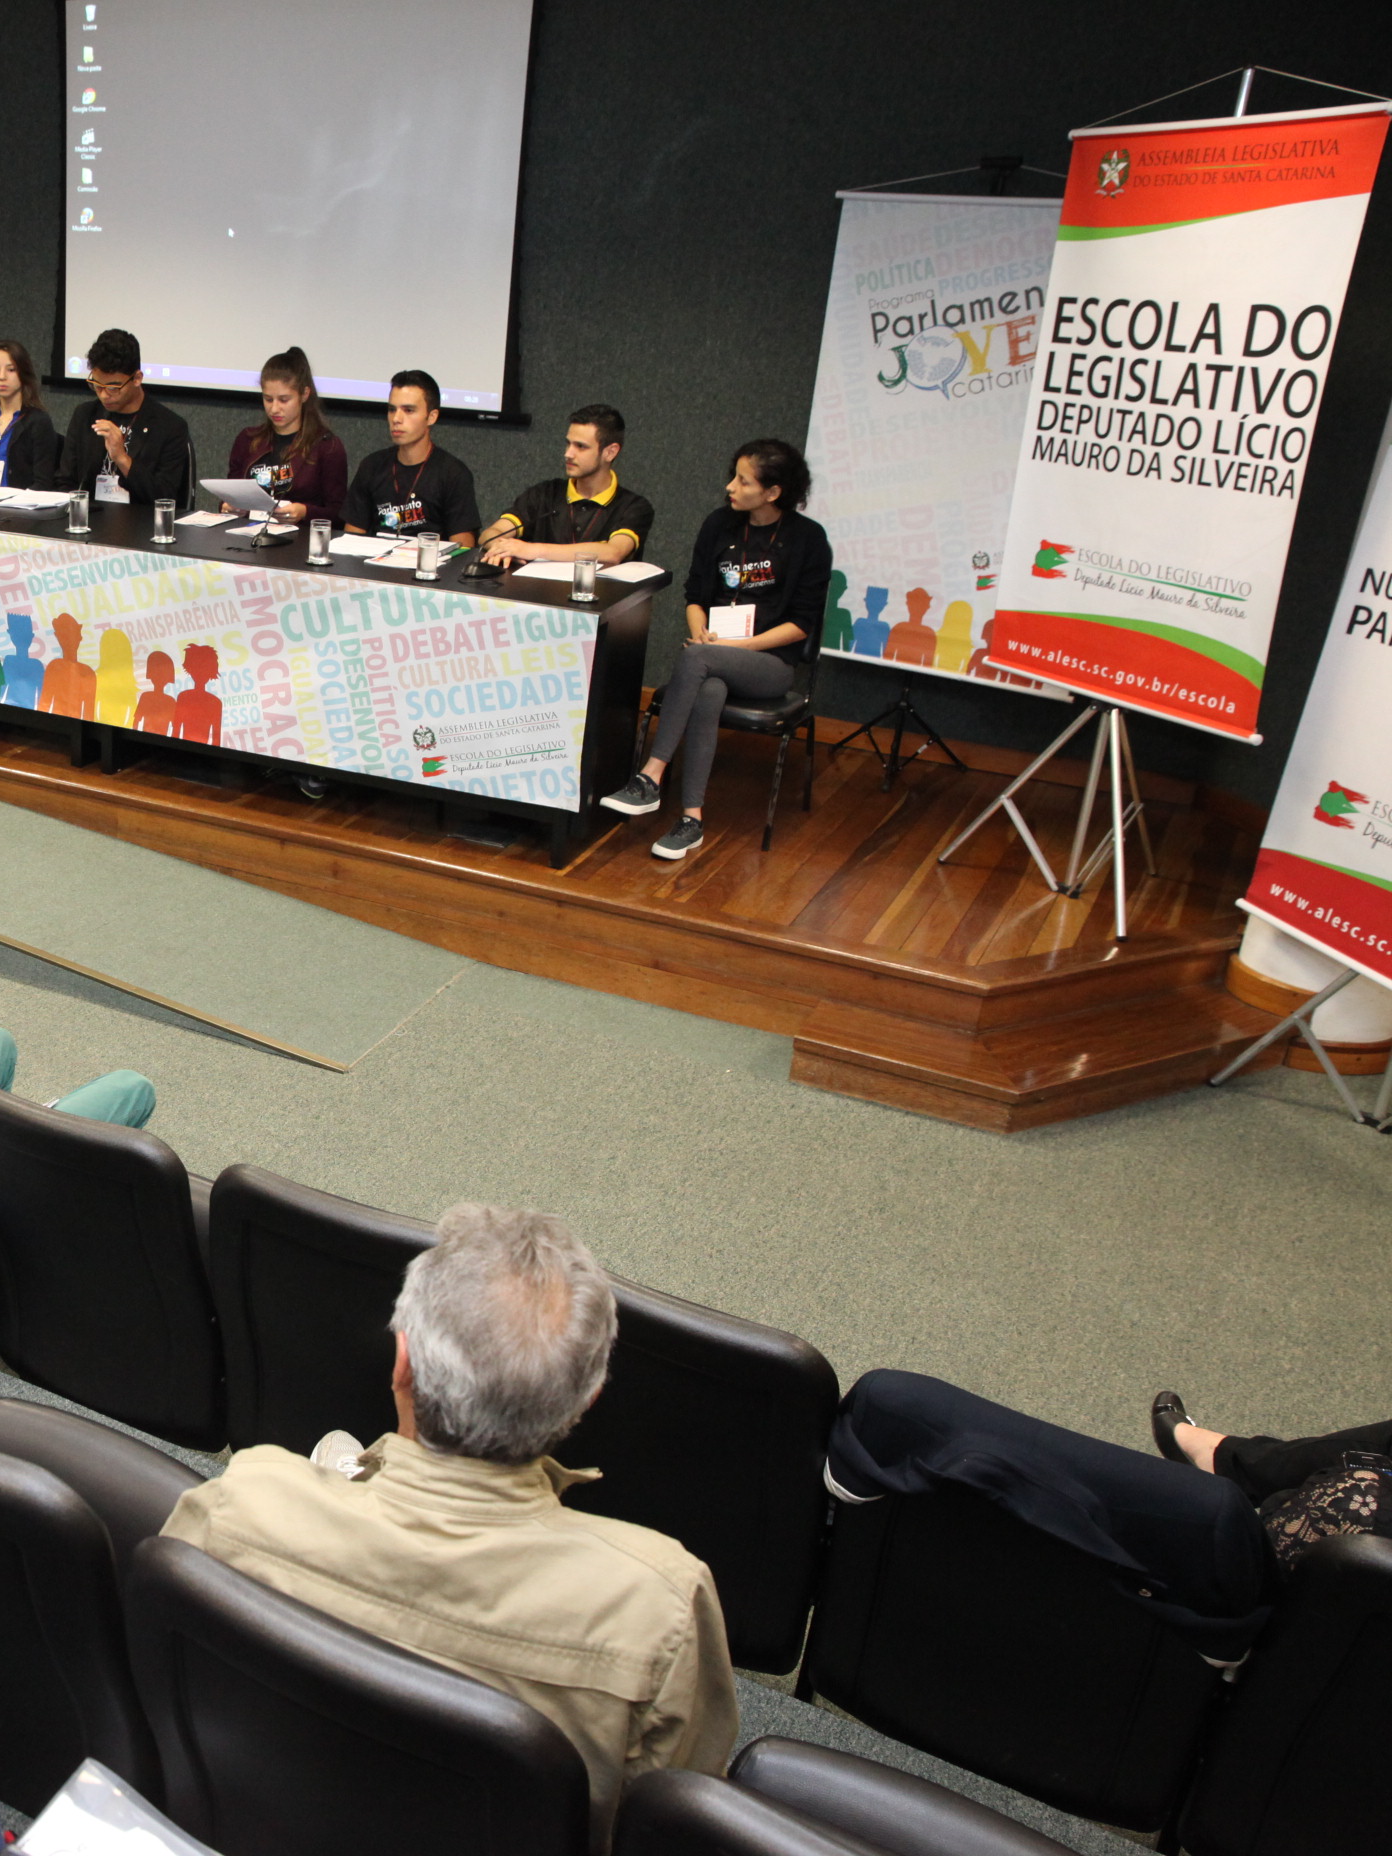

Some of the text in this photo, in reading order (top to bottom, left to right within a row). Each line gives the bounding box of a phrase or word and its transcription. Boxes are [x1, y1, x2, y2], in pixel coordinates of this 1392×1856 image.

[1134, 166, 1336, 188] DO ESTADO DE SANTA CATARINA
[1137, 139, 1340, 167] ASSEMBLEIA LEGISLATIVA
[855, 256, 936, 295] POLÍTICA
[1051, 296, 1333, 361] ESCOLA DO
[877, 314, 1038, 393] JOVE
[1043, 350, 1318, 419] LEGISLATIVO
[1036, 400, 1202, 451] DEPUTADO
[1212, 414, 1307, 464] LÍCIO
[1031, 434, 1296, 499] MAURO DA SILVEIRA
[34, 560, 229, 628] IGUALDADE
[1077, 547, 1253, 599] ESCOLA DO LEGISLATIVO
[117, 600, 242, 645] TRANSPARÊNCIA
[280, 586, 475, 643] CULTURA
[1147, 585, 1185, 606] Mauro
[1186, 594, 1201, 609] da
[1202, 596, 1248, 621] Silveira
[389, 615, 511, 665] DEBATE
[397, 642, 580, 690] CULTURA LEIS
[1007, 638, 1237, 715] www.alesc.sc.gov.br/escola
[222, 693, 259, 708] MENTO
[223, 705, 261, 728] ESSO
[361, 637, 404, 750] POLÍTICA
[405, 670, 585, 722] SOCIEDADE
[222, 726, 268, 754] ATE
[438, 711, 559, 736] ASSEMBLEIA LEGISLATIVA
[439, 722, 561, 745] DO ESTADO DE SANTA CATARINA
[449, 739, 567, 763] ESCOLA DO LEGISLATIVO
[529, 753, 539, 762] da
[539, 750, 569, 763] Silveira
